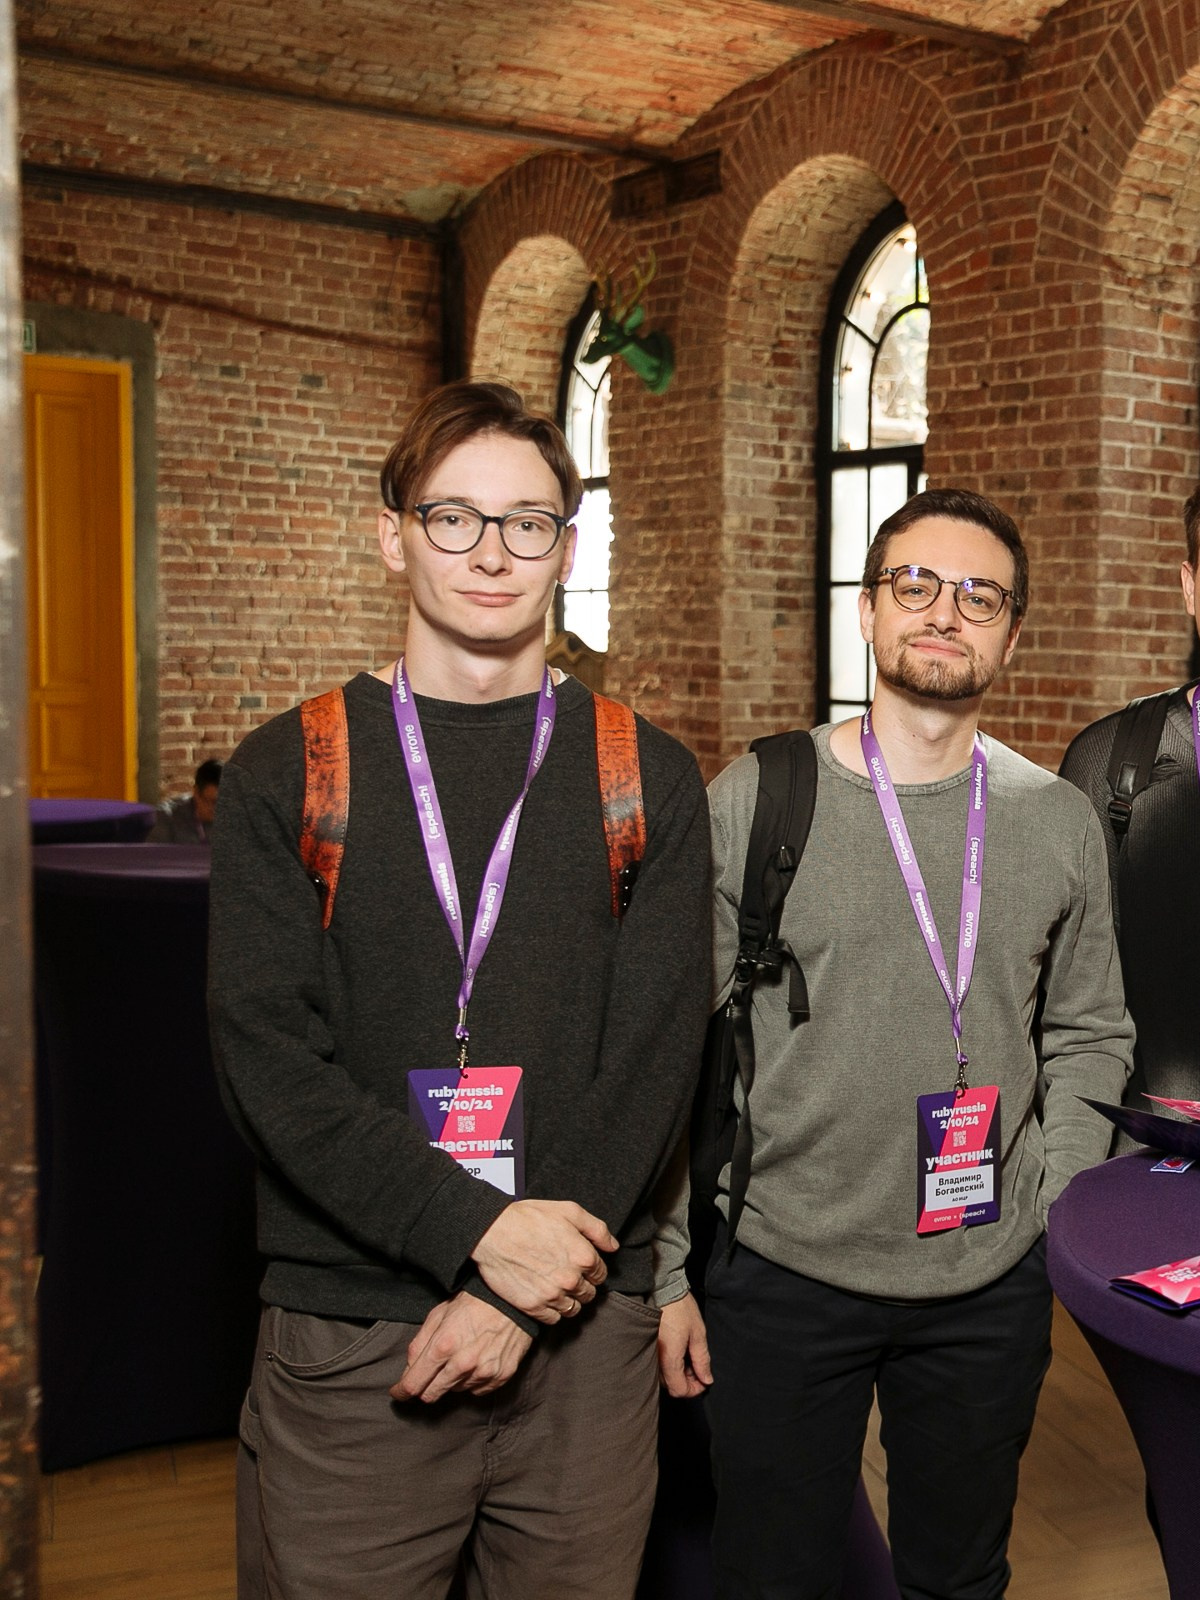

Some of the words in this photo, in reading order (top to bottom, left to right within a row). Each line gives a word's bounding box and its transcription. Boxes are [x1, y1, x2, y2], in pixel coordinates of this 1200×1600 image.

[405, 724, 421, 763] evrone
[870, 757, 889, 791] evrone
[974, 763, 984, 810] rubyrussia
[437, 862, 458, 920] rubyrussia
[915, 891, 936, 943] rubyrussia
[963, 911, 974, 948] evrone
[428, 1084, 504, 1099] rubyrussia
[439, 1099, 494, 1112] 2/10/24
[932, 1101, 987, 1119] rubyrussia
[939, 1115, 979, 1130] 2/10/24
[429, 1138, 514, 1153] частник
[926, 1148, 994, 1171] участник
[935, 1181, 985, 1196] Богаевский
[938, 1173, 982, 1187] Владимир
